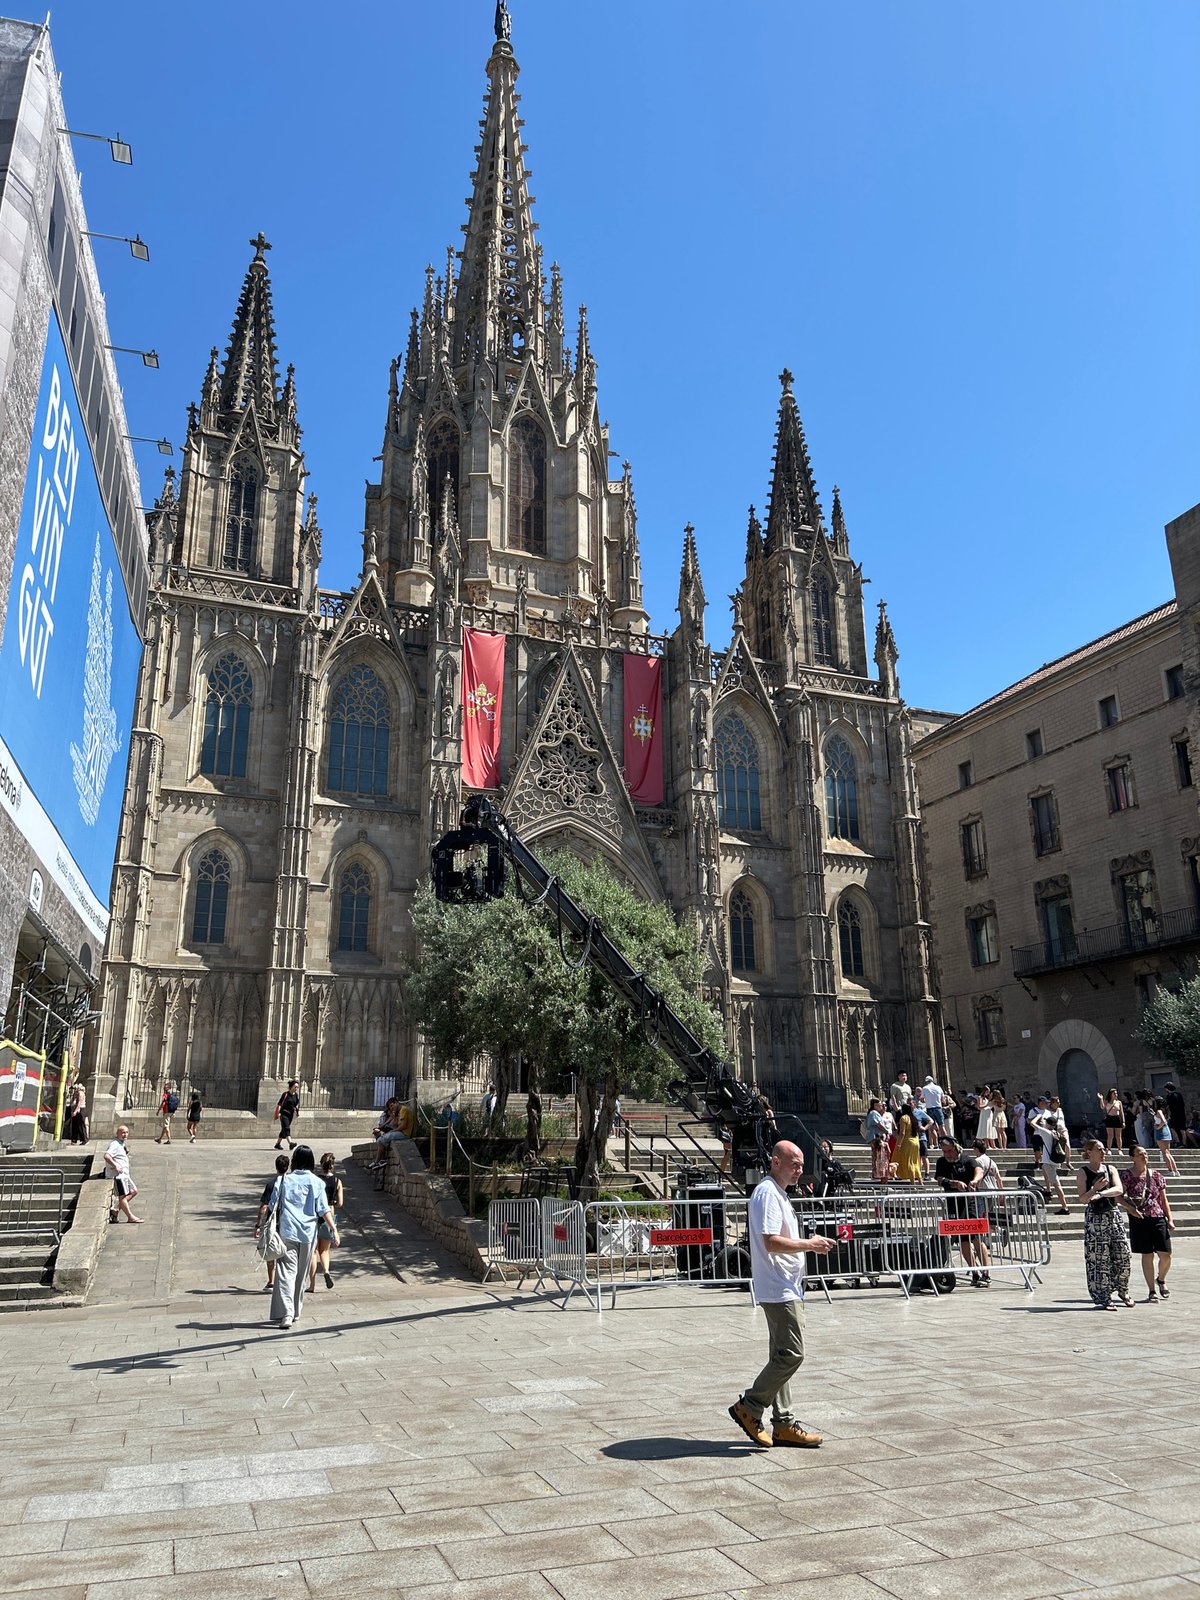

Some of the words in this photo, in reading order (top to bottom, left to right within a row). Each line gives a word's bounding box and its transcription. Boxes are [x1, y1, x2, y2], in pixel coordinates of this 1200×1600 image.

[43, 363, 80, 527] BEN
[31, 453, 64, 605] VIN
[18, 563, 54, 699] GUT
[656, 1232, 698, 1242] Barcelona
[944, 1222, 977, 1232] Barcelona
